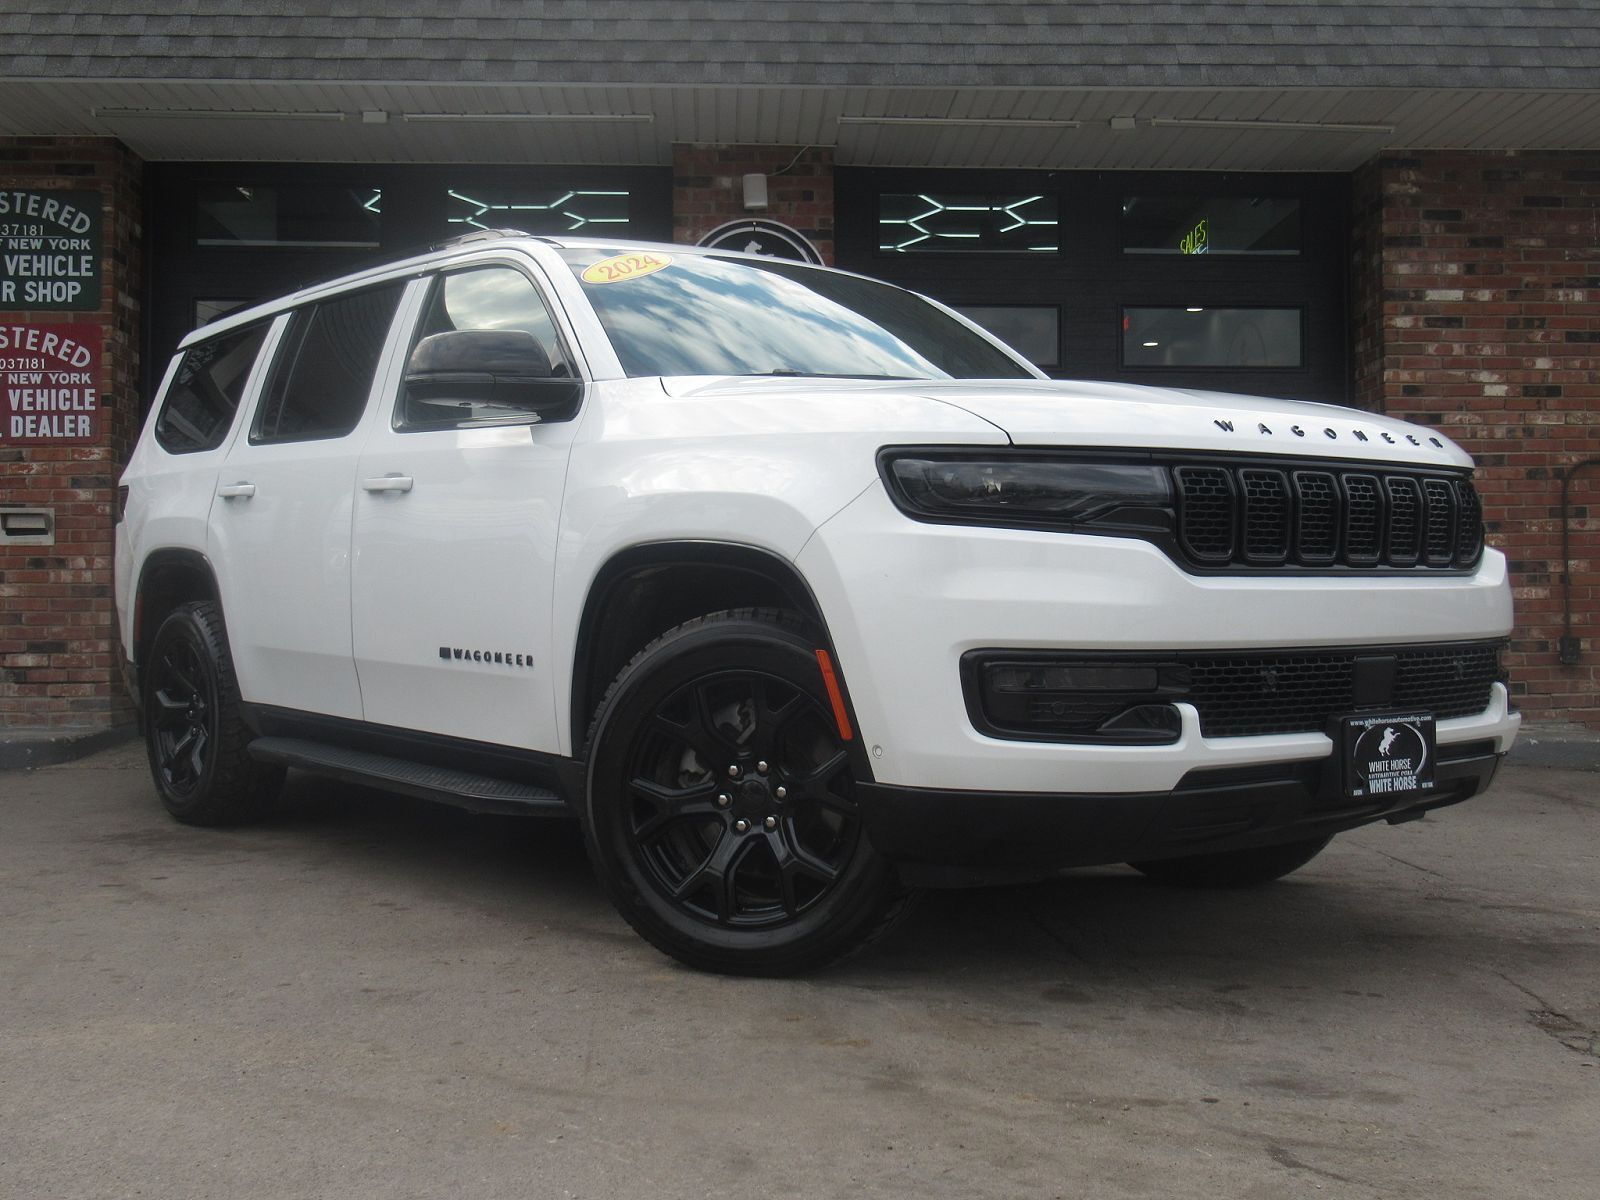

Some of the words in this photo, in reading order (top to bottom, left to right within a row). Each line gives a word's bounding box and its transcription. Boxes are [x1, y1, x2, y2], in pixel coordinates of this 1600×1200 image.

[8, 239, 43, 250] NEW
[48, 239, 91, 250] YORK
[1180, 219, 1206, 255] SALES
[4, 255, 93, 277] VEHICLE
[598, 255, 661, 280] 2024
[24, 281, 82, 302] SHOP
[8, 373, 43, 385] NEW
[48, 373, 92, 385] YORK
[8, 388, 96, 411] VEHICLE
[10, 415, 91, 437] DEALER
[1214, 420, 1443, 448] WAGONEER
[453, 648, 534, 667] WAGONEER
[1369, 761, 1389, 772] WHITE
[1391, 759, 1411, 770] HORSE
[1369, 779, 1392, 793] WHITE
[1394, 776, 1416, 791] HORSE
